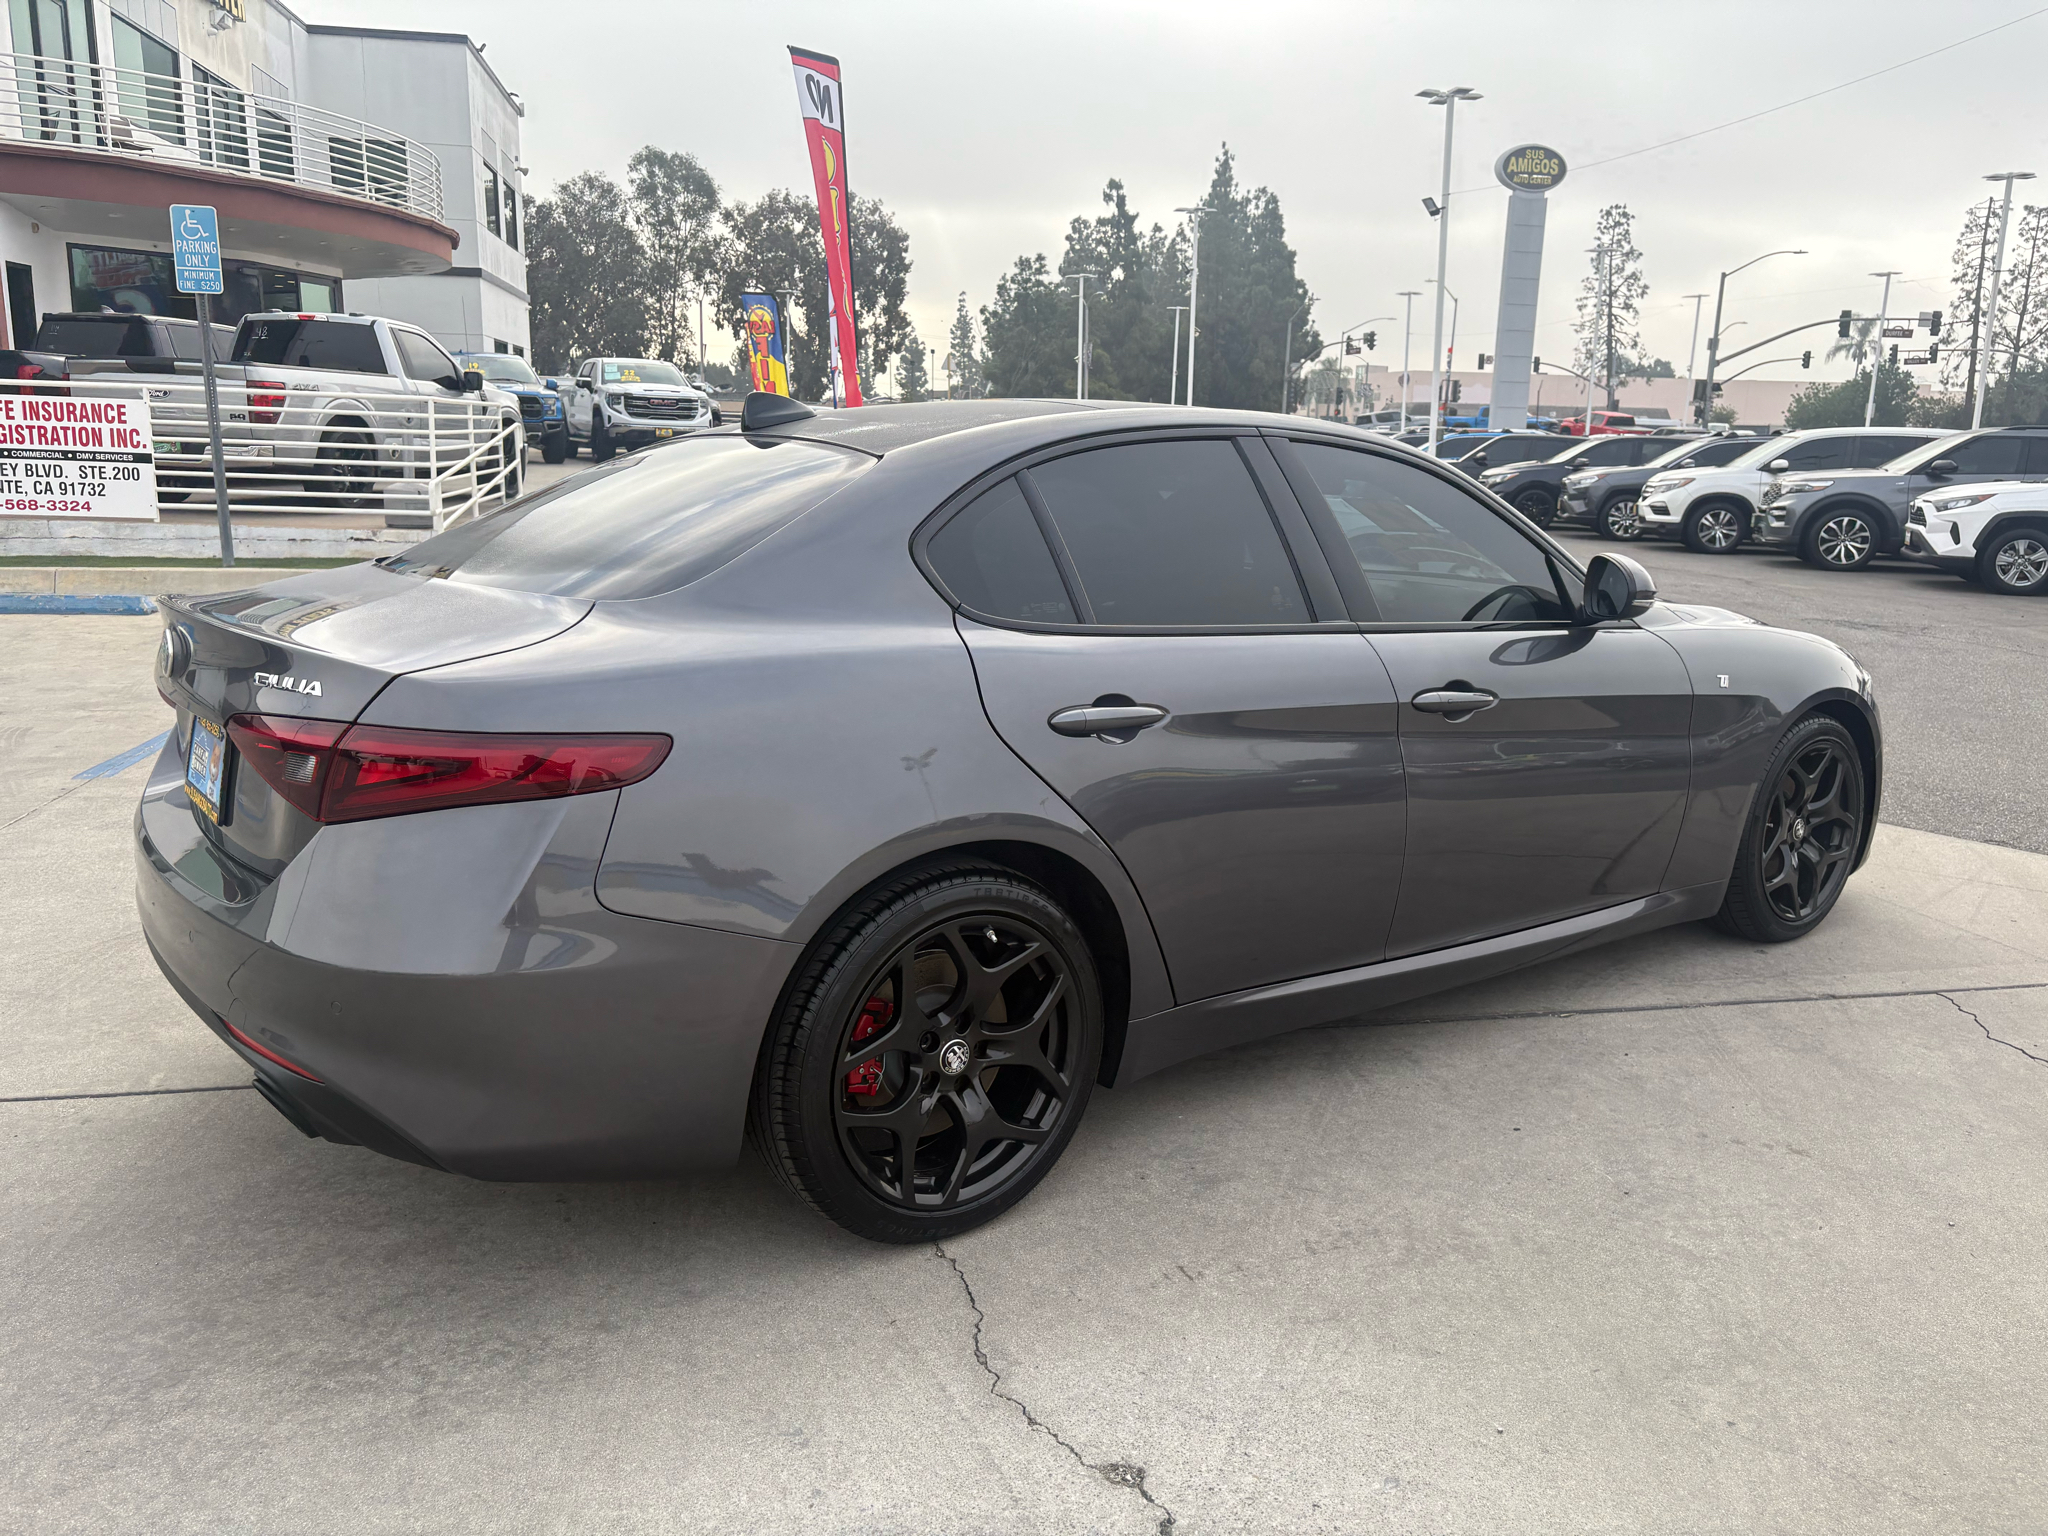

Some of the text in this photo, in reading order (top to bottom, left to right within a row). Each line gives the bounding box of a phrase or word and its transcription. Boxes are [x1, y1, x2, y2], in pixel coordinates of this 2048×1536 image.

[1525, 149, 1545, 159] SUS
[1507, 156, 1559, 175] AMIGOS
[1513, 174, 1552, 184] AUTO CENTER
[176, 240, 217, 254] PARKING
[185, 254, 210, 267] ONLY
[184, 270, 215, 280] MINIMUM
[180, 280, 220, 291] FINE $250
[22, 400, 127, 424] INSURANCE
[109, 428, 147, 449] INC.
[11, 451, 65, 459] COMMERCIAL
[95, 453, 134, 461] SERVICES
[25, 463, 69, 479] BLVD.
[79, 465, 141, 481] STE.200
[33, 481, 54, 495] CA
[59, 482, 106, 497] 91732
[253, 672, 323, 697] GIULIA
